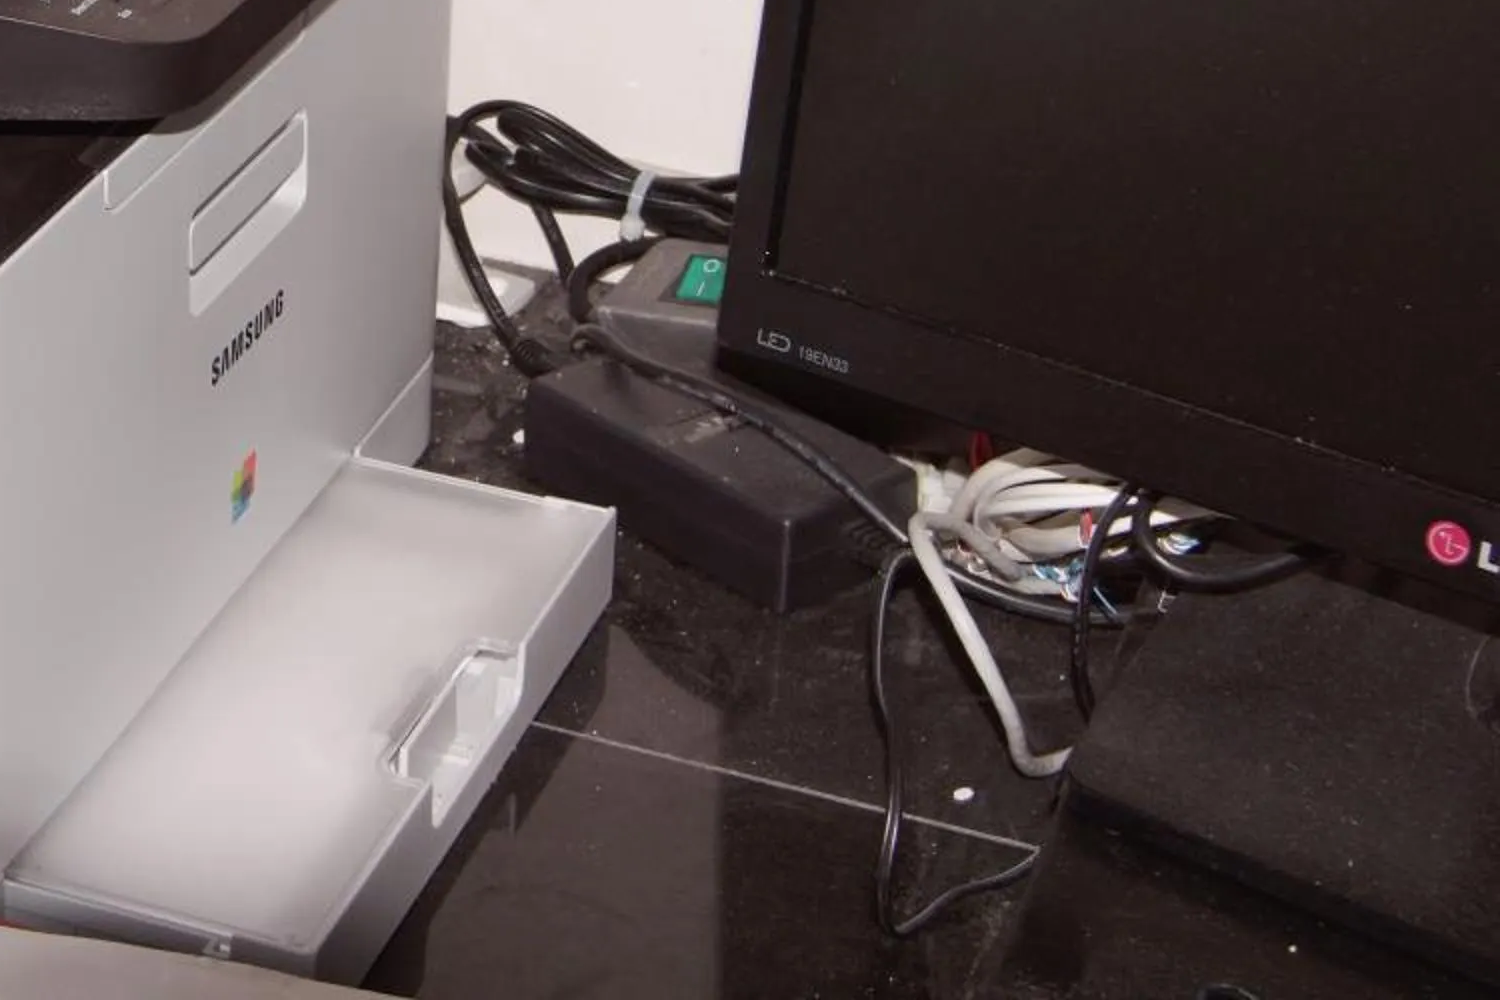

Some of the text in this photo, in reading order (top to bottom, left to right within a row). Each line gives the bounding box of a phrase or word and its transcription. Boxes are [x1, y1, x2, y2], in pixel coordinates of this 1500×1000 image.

[211, 289, 284, 386] SAMSUNG
[757, 327, 849, 374] LED 19EN33
